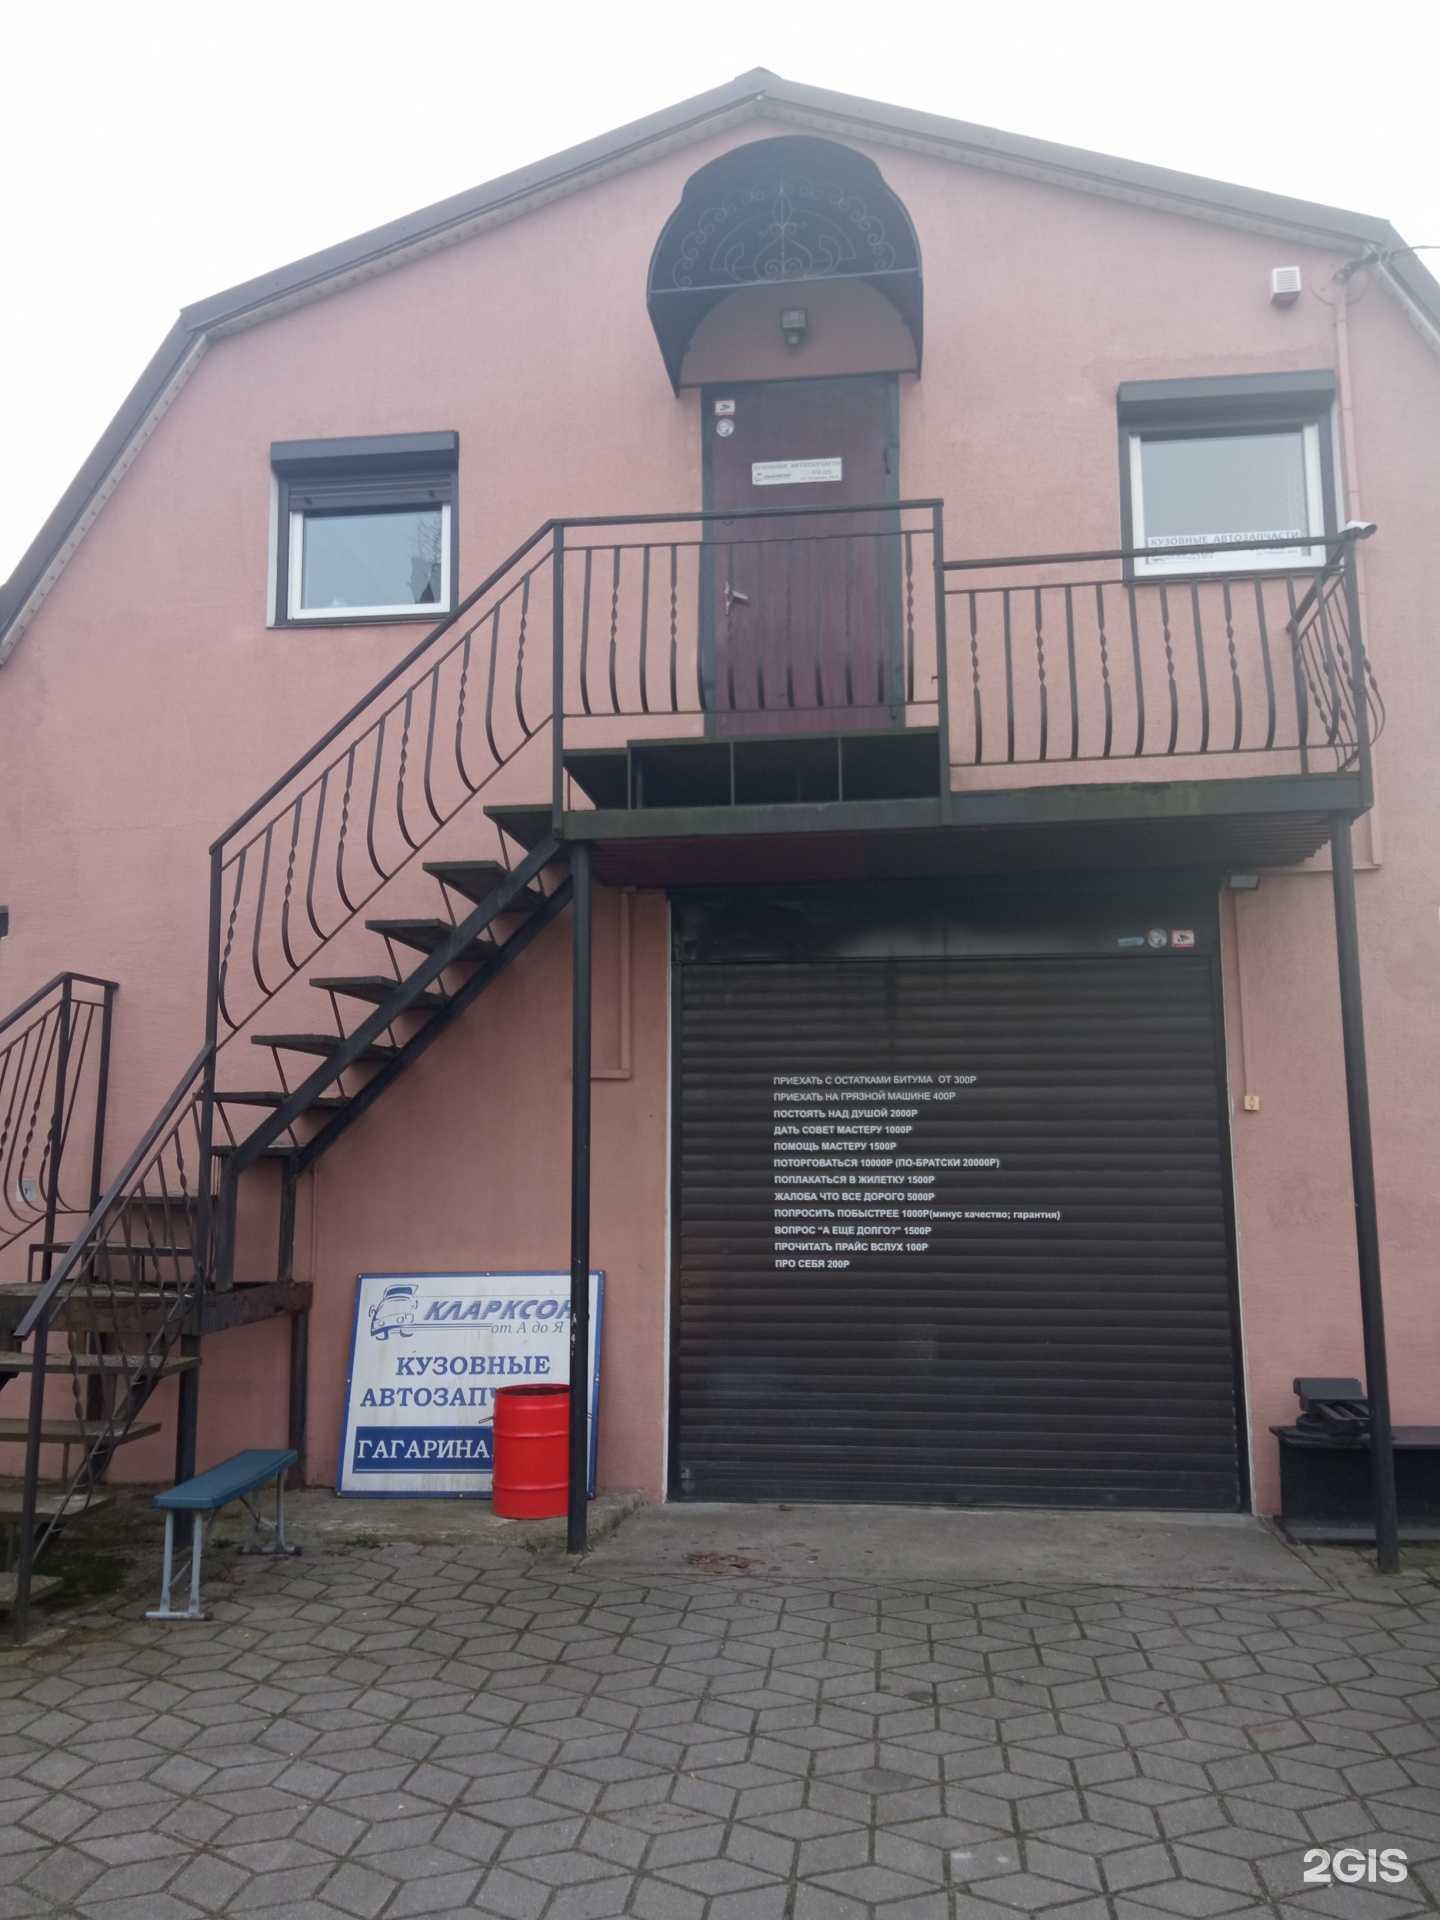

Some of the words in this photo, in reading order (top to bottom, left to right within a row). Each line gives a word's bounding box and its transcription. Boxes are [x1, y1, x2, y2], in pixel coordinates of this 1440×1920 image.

[773, 1076, 823, 1085] ПРИЕХАТЬ
[824, 1076, 833, 1084] С
[834, 1076, 891, 1084] ОСТАТКАМИ
[893, 1075, 934, 1084] БИТУМА
[937, 1075, 952, 1083] ОТ
[954, 1076, 977, 1084] 300Р
[773, 1092, 824, 1101] ПРИЕХАТЬ
[825, 1093, 839, 1101] НА
[840, 1091, 886, 1100] ГРЯЗНОЙ
[887, 1092, 931, 1100] МАШИНЕ
[932, 1092, 957, 1100] 400Р
[773, 1110, 827, 1118] ПОСТОЯТЬ
[827, 1110, 850, 1119] НАД
[850, 1108, 889, 1119] ДУШОЙ
[890, 1109, 919, 1117] 2000Р
[773, 1126, 800, 1136] ДАТЬ
[801, 1126, 835, 1134] СОВЕТ
[836, 1125, 883, 1134] МАСТЕРУ
[884, 1125, 913, 1134] 1000Р
[773, 1142, 820, 1152] ПОМОЩЬ
[821, 1142, 868, 1150] МАСТЕРУ
[869, 1142, 898, 1150] 1500Р
[773, 1159, 859, 1167] ПОТОРГОВАТЬСЯ
[860, 1159, 894, 1167] 10000Р
[773, 1176, 847, 1184] ПОПЛАКАТЬСЯ
[848, 1176, 857, 1184] В
[857, 1176, 905, 1184] ЖИЛЕТКУ
[907, 1176, 937, 1184] 1500Р
[773, 1192, 818, 1200] ЖАЛОБА
[819, 1192, 840, 1200] ЧТО
[841, 1192, 862, 1201] ВСЕ
[863, 1192, 905, 1202] ДОРОГО
[906, 1193, 936, 1201] 5000Р
[773, 1209, 836, 1217] ПОПРОСИТЬ
[836, 1209, 900, 1217] ПОБЫСТРЕЕ
[773, 1226, 816, 1234] ВОПРОС
[831, 1226, 855, 1236] ЕЩЕ
[903, 1226, 933, 1235] 1500Р
[774, 1242, 833, 1251] ПРОЧИТАТЬ
[834, 1241, 869, 1251] ПРАЙС
[870, 1243, 904, 1251] ВСЛУХ
[905, 1243, 929, 1251] 100Р
[774, 1259, 797, 1268] ПРО
[797, 1260, 826, 1268] СЕБЯ
[826, 1260, 851, 1268] 200Р
[491, 1324, 512, 1334] от
[516, 1322, 528, 1334] А
[532, 1321, 549, 1334] до
[552, 1322, 564, 1334] Я
[395, 1355, 551, 1376] КУЗОВНЫЕ
